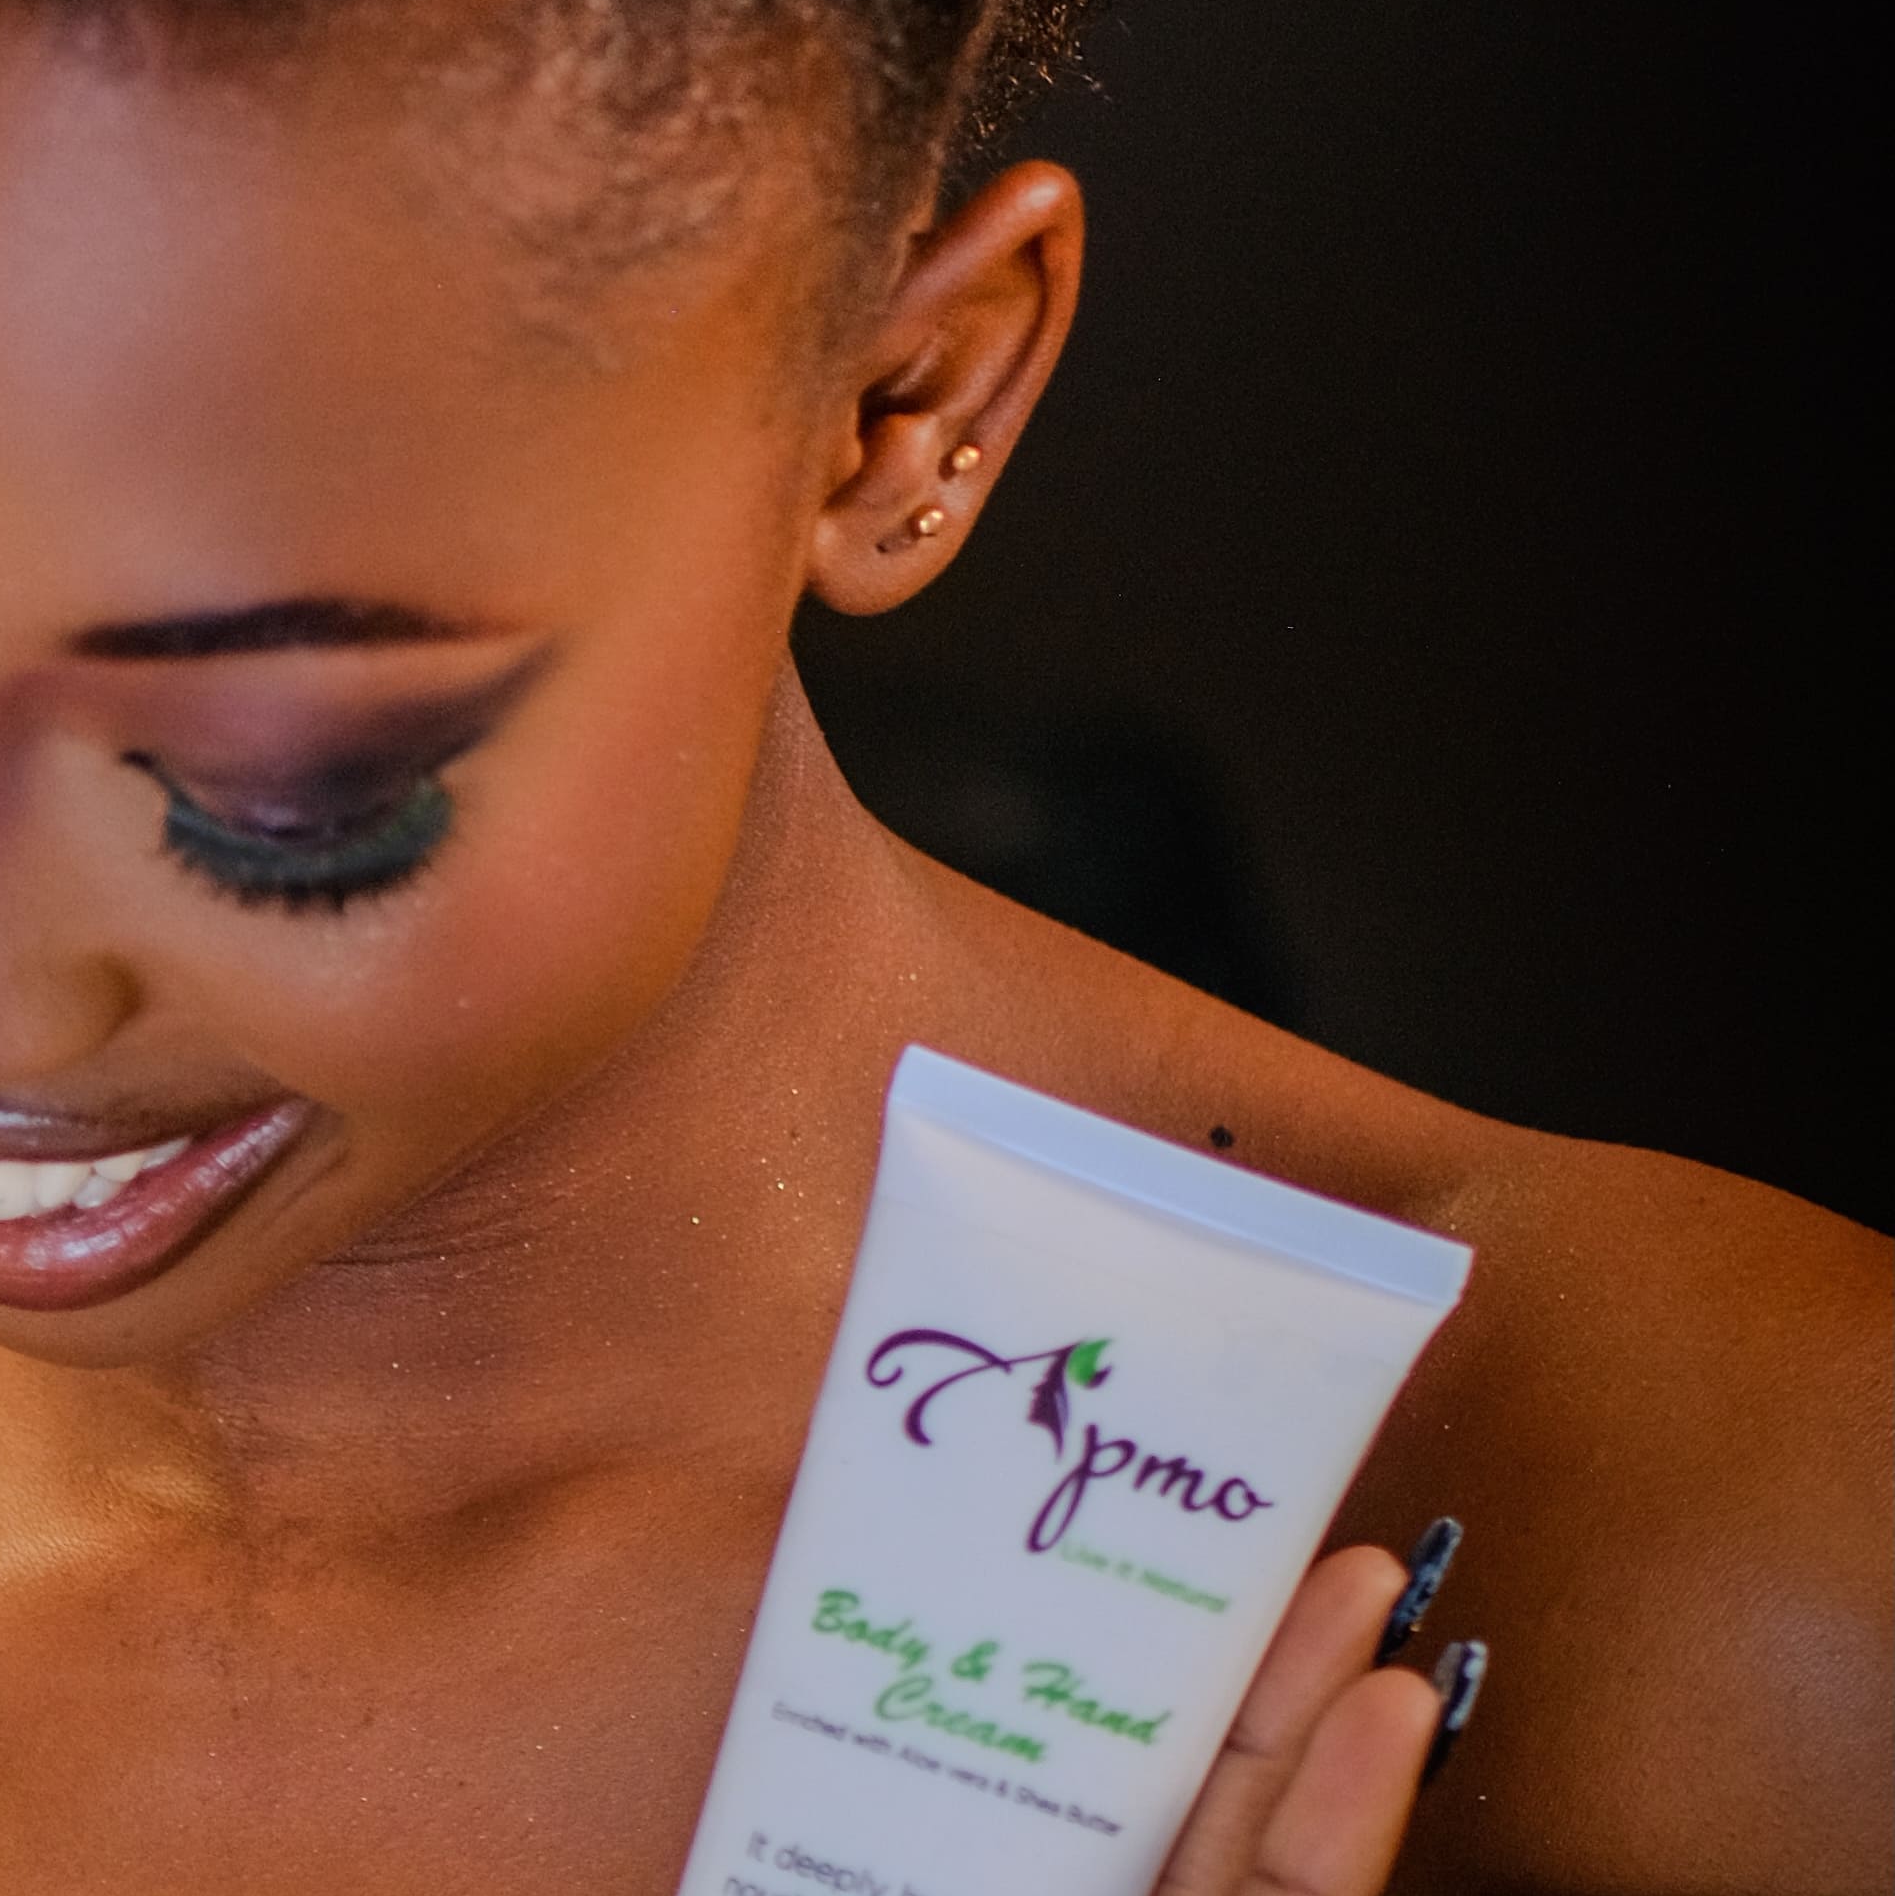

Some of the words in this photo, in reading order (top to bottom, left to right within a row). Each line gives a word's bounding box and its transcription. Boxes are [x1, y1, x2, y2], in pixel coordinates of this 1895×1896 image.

[810, 1588, 931, 1671] Body
[950, 1639, 1000, 1682] &
[1022, 1659, 1173, 1746] Hand
[874, 1675, 1047, 1764] Cream
[747, 1830, 768, 1862] It
